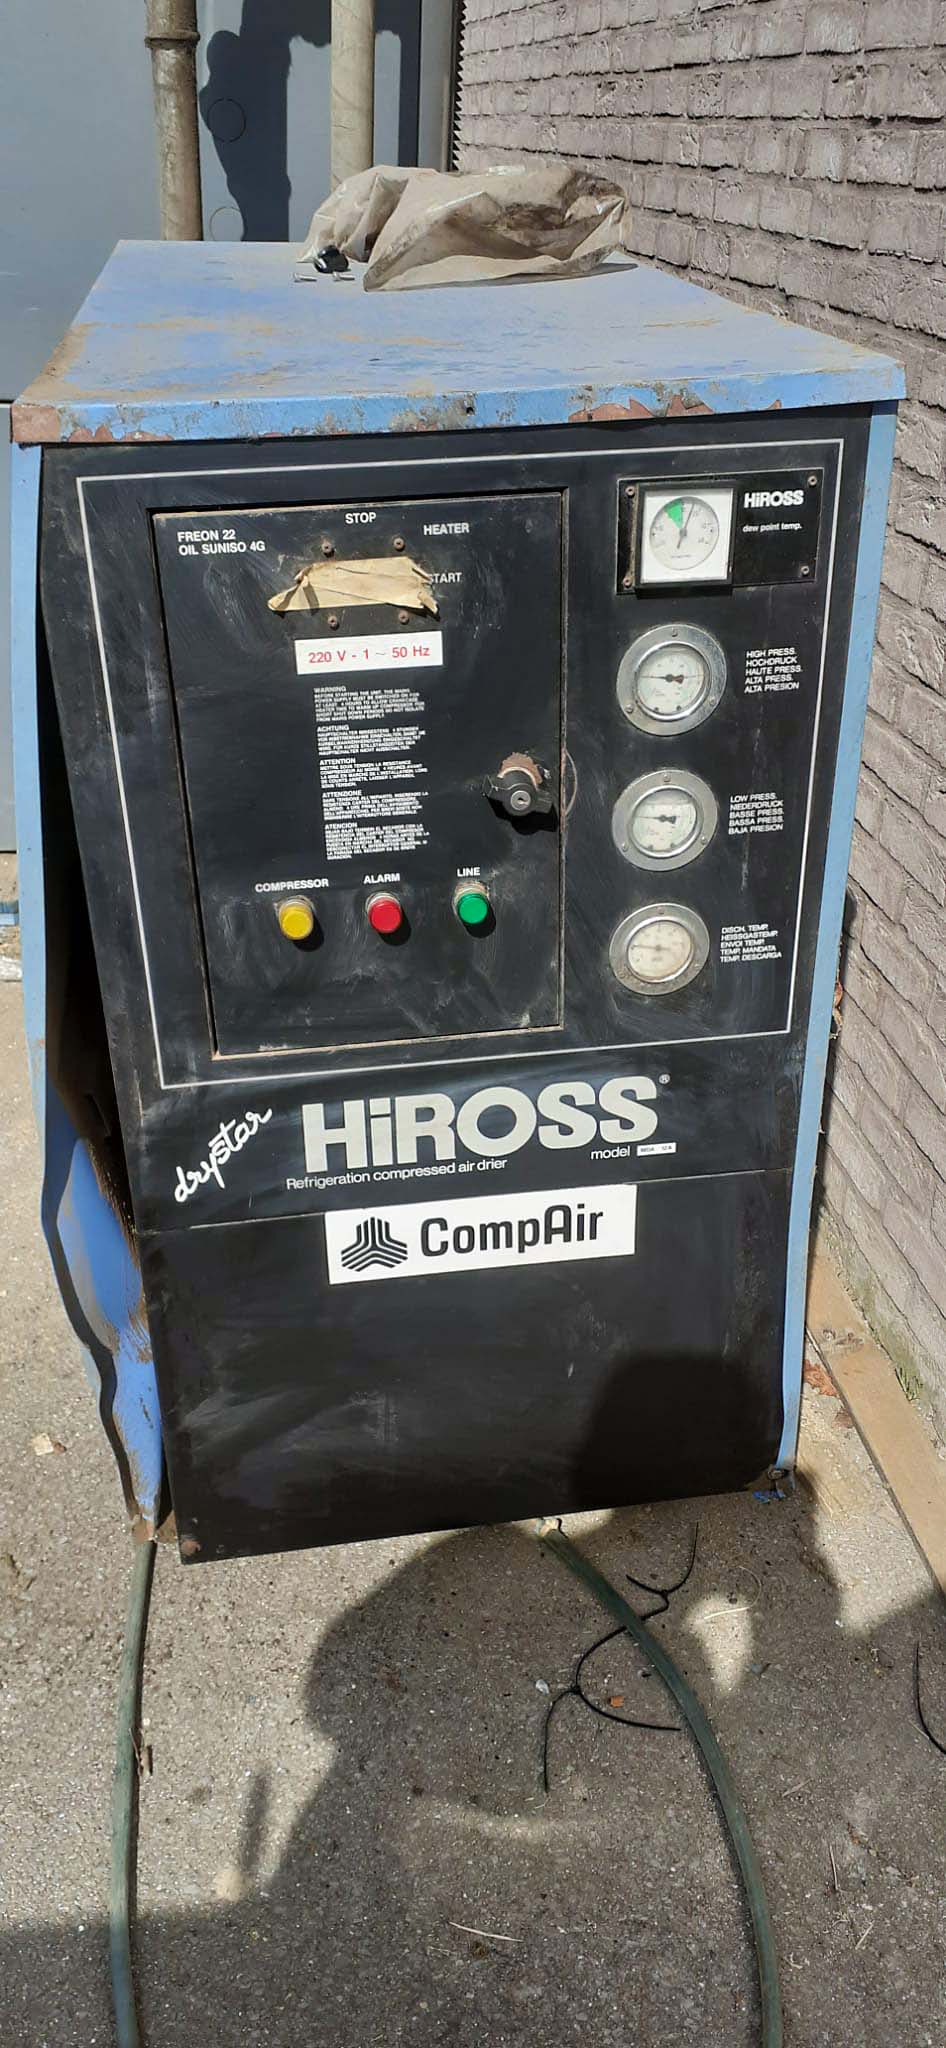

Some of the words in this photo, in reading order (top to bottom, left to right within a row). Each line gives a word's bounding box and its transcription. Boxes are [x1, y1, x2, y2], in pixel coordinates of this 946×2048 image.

[744, 490, 804, 508] HiROSS
[345, 512, 376, 524] STOP
[423, 522, 469, 535] HEATER
[760, 523, 779, 532] point
[177, 530, 219, 542] FREON
[222, 529, 236, 540] 22
[179, 545, 199, 556] OIL
[202, 542, 246, 554] SUNISO
[250, 541, 265, 551] 4G
[308, 651, 332, 663] 220
[337, 650, 346, 661] V
[363, 648, 369, 660] 1
[392, 646, 408, 658] 50
[412, 645, 430, 657] Hz
[746, 650, 766, 658] HIGH
[746, 656, 798, 667] HOCHDRUCK
[745, 667, 773, 676] HAUTE
[744, 676, 763, 685] ALTA
[744, 685, 762, 693] ALTA
[317, 724, 349, 732] ACHTUNG
[320, 757, 356, 766] ATTENTION
[322, 790, 361, 798] ATTENZIONE
[730, 795, 748, 803] LOW
[729, 810, 756, 819] BASSE
[325, 822, 357, 830] ATENCION
[729, 818, 755, 827] BASSA
[728, 826, 748, 835] BAJA
[457, 867, 481, 877] LINE
[363, 873, 401, 885] ALARM
[255, 878, 329, 893] COMPRESSOR
[302, 1076, 658, 1173] HiROSS
[174, 1108, 273, 1203] drystar
[590, 1145, 631, 1160] model
[286, 1171, 370, 1190] Refrigeration
[373, 1164, 456, 1182] compressed
[458, 1161, 475, 1173] air
[477, 1159, 508, 1171] drier
[421, 1203, 603, 1257] CompAir
